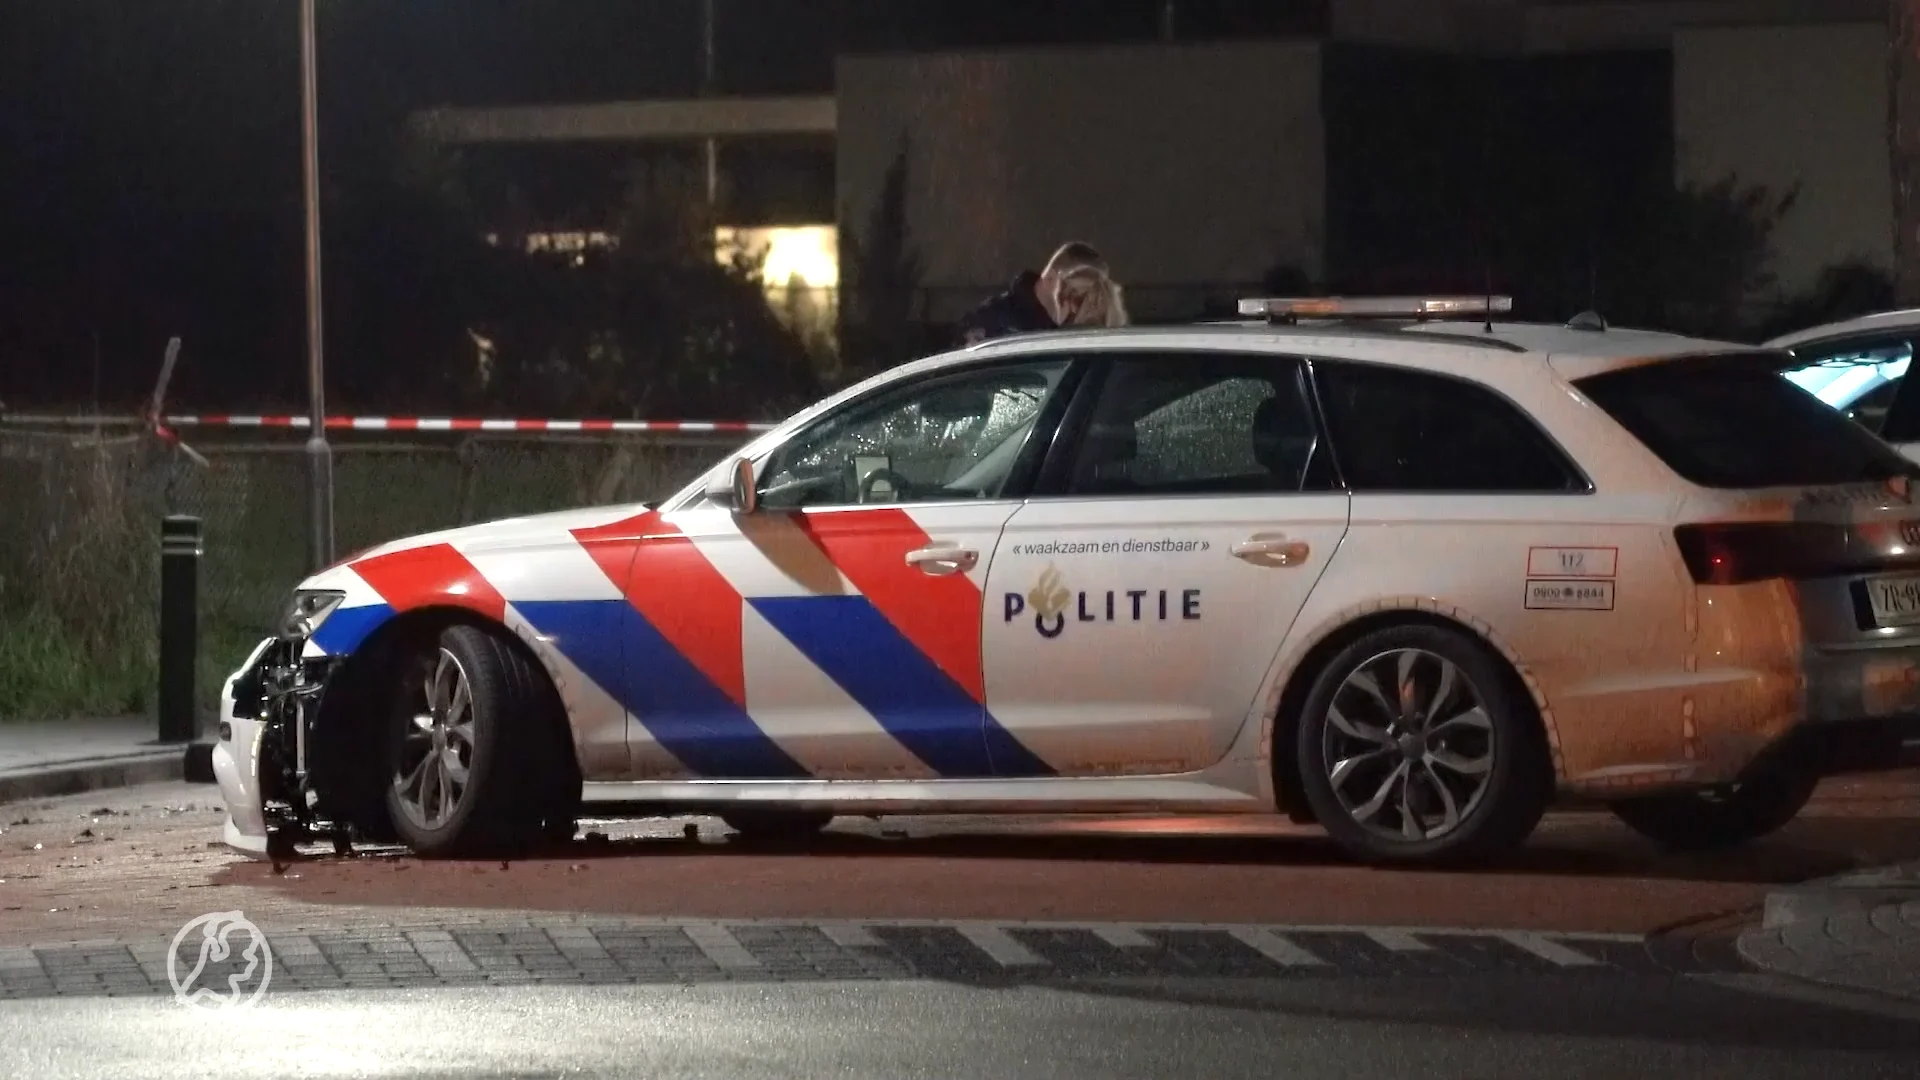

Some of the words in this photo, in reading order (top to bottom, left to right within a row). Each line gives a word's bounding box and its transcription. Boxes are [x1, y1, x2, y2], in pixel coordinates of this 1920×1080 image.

[1025, 540, 1099, 554] waakzaam
[1102, 542, 1119, 553] en
[1123, 538, 1198, 552] dienstbaar
[1560, 552, 1584, 568] 112
[1004, 588, 1201, 639] POLITIE
